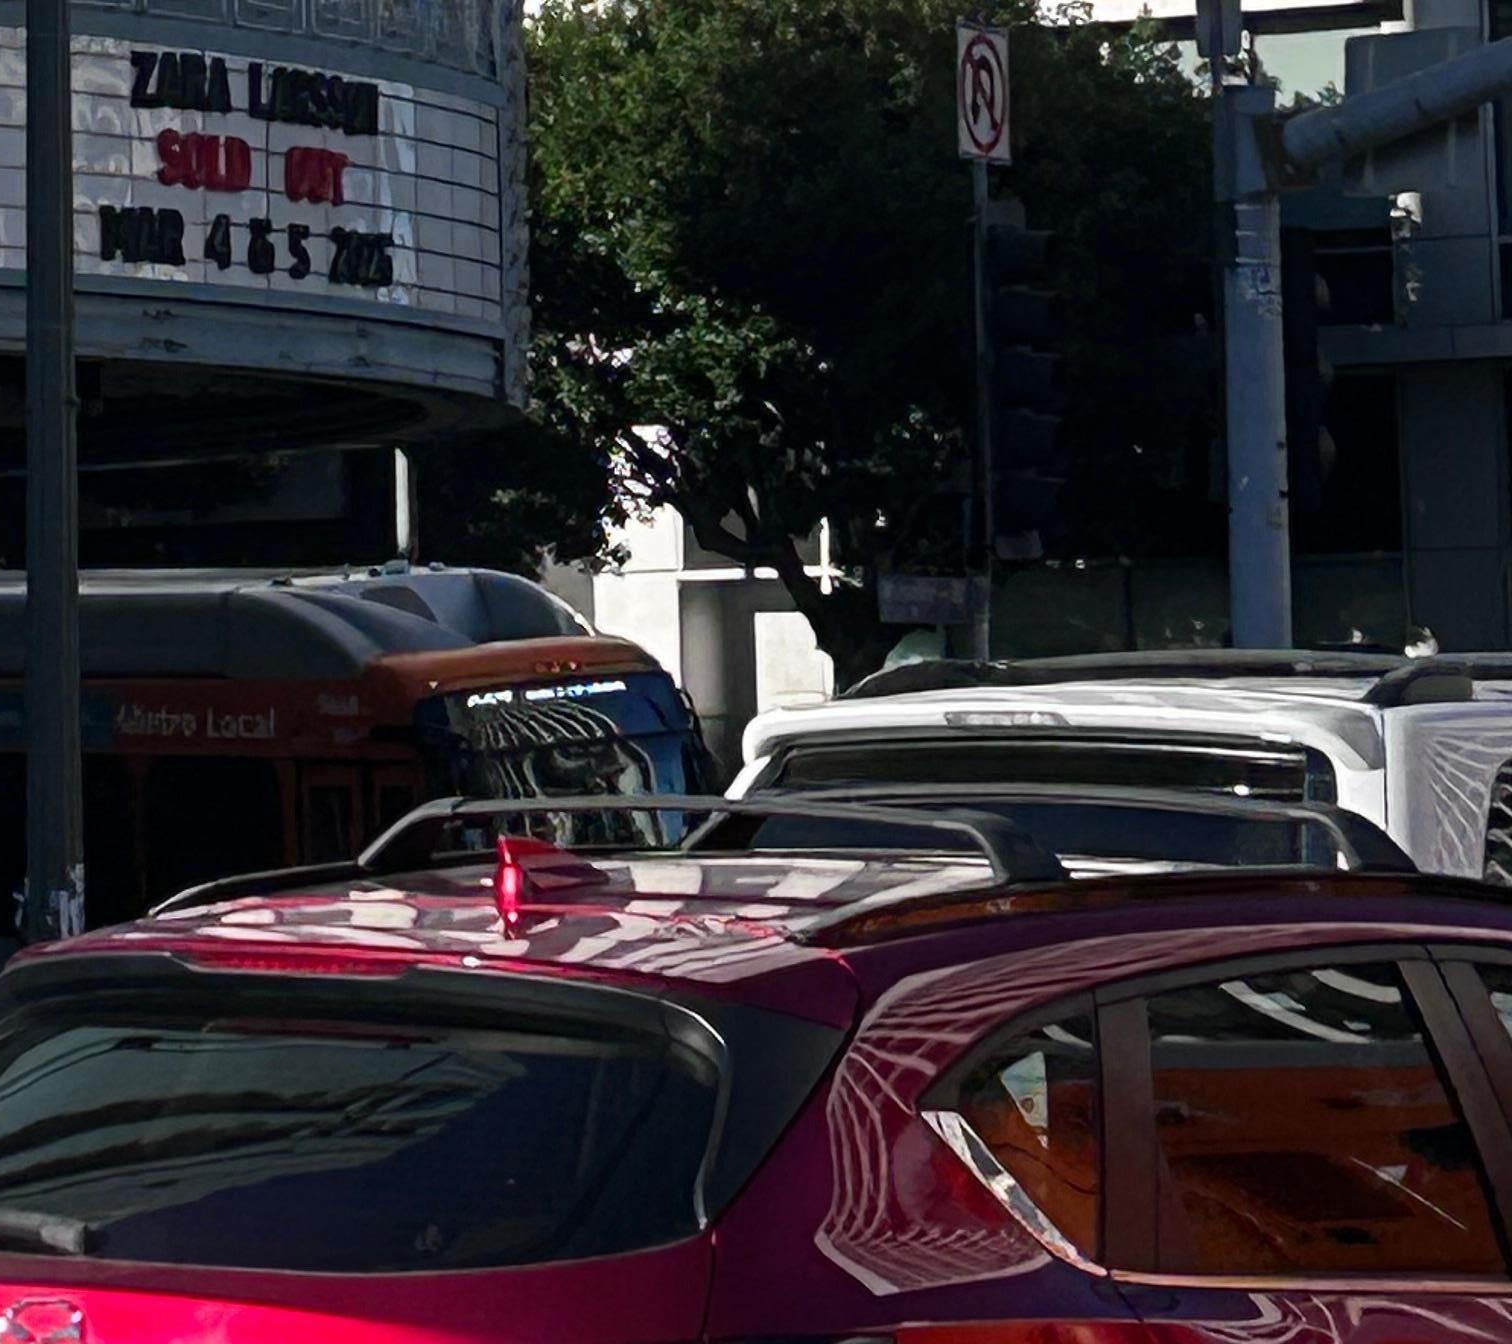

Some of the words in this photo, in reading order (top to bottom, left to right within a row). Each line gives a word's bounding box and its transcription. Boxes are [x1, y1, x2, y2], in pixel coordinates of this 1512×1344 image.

[131, 50, 232, 114] ZARA
[157, 128, 251, 193] SOLD
[284, 146, 349, 207] OUT
[204, 214, 232, 270] 4
[288, 223, 311, 279] 5
[206, 705, 276, 739] Local
